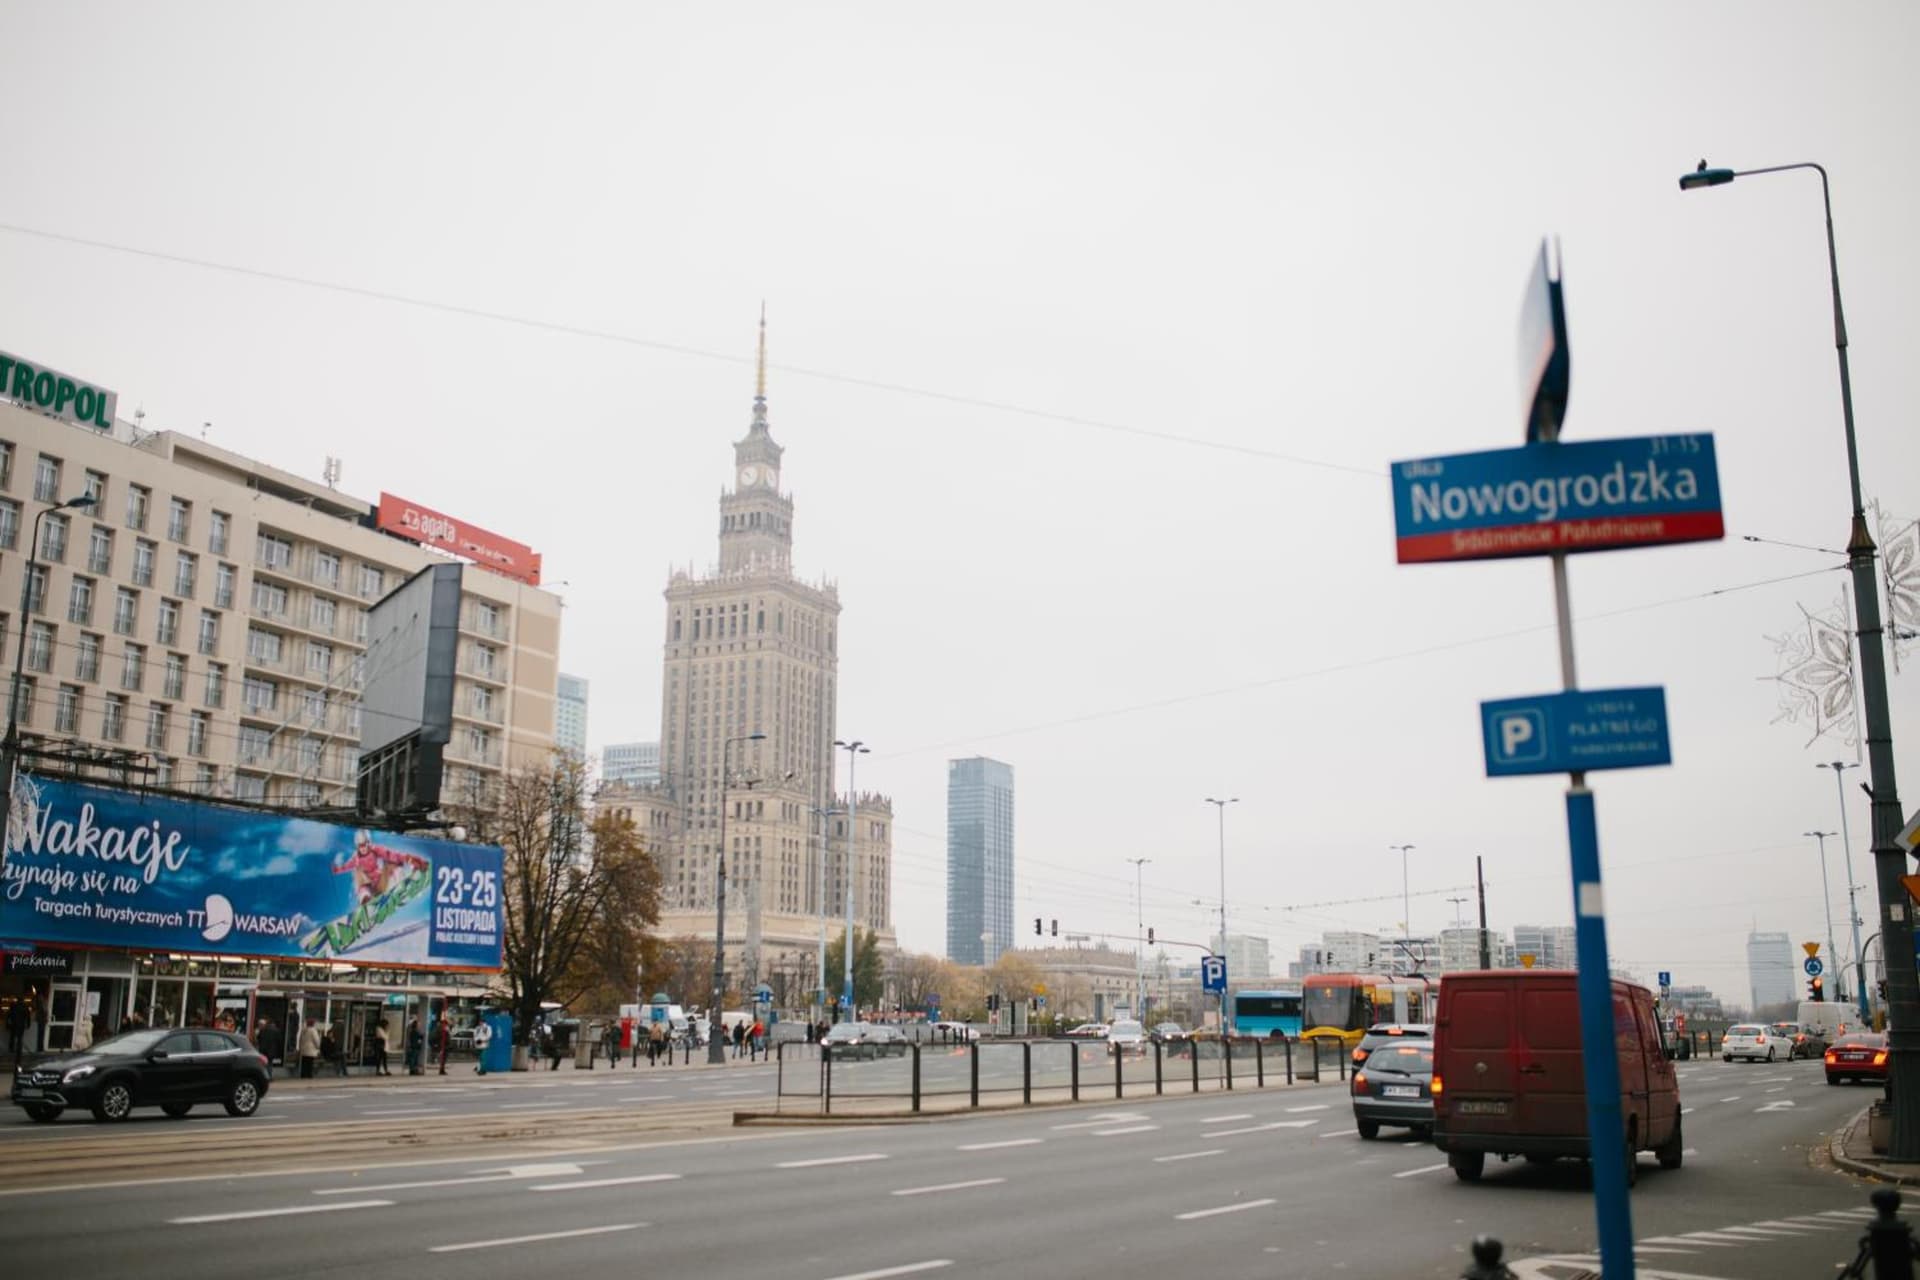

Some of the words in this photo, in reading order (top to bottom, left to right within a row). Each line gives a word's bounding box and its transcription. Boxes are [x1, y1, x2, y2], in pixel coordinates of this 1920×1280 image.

[0, 355, 111, 429] TROPOL
[1410, 459, 1698, 524] Nowogrodzka
[421, 515, 456, 542] agata
[1502, 717, 1533, 756] P
[10, 802, 190, 884] Wakacje
[81, 869, 109, 896] się
[113, 875, 141, 894] na
[437, 866, 496, 907] 23-25
[34, 897, 91, 917] Targach
[96, 903, 182, 926] Turystycznych
[187, 910, 206, 928] TT
[234, 915, 300, 934] WARSAW
[436, 907, 496, 932] LISTOPADA
[11, 953, 66, 970] piekarnia
[1207, 963, 1222, 985] P
